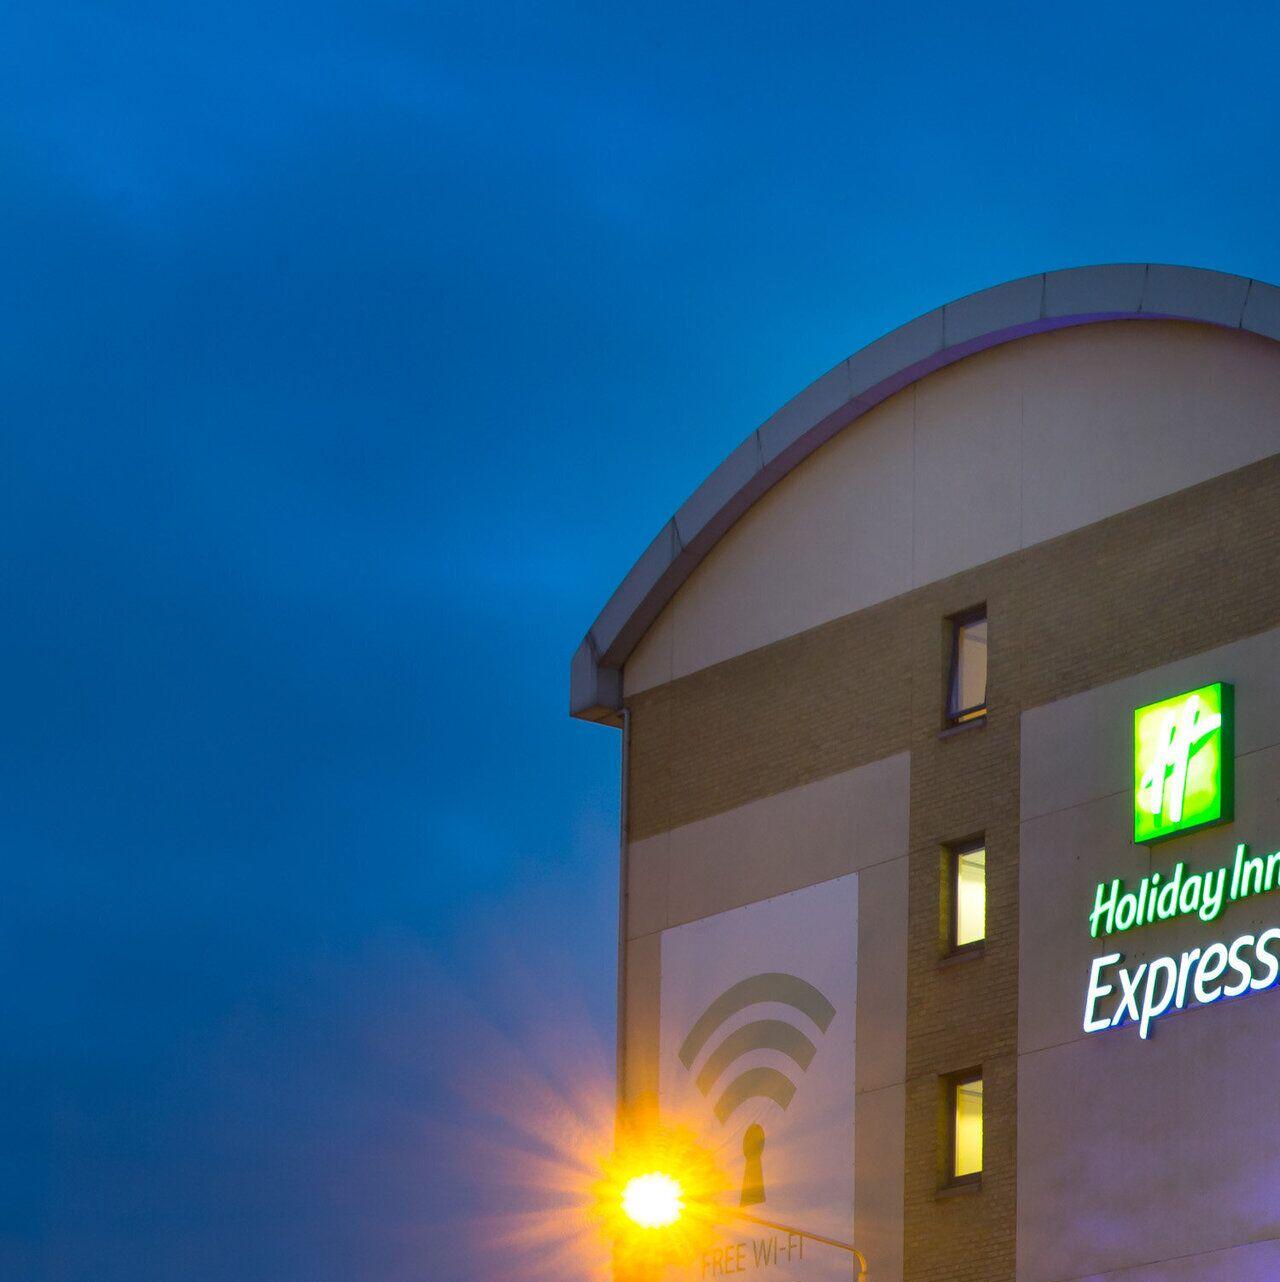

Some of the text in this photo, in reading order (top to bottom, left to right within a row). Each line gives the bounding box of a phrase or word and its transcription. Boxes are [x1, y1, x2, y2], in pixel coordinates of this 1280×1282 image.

[1089, 861, 1227, 938] Holiday
[701, 1231, 804, 1280] FREE WI-FI
